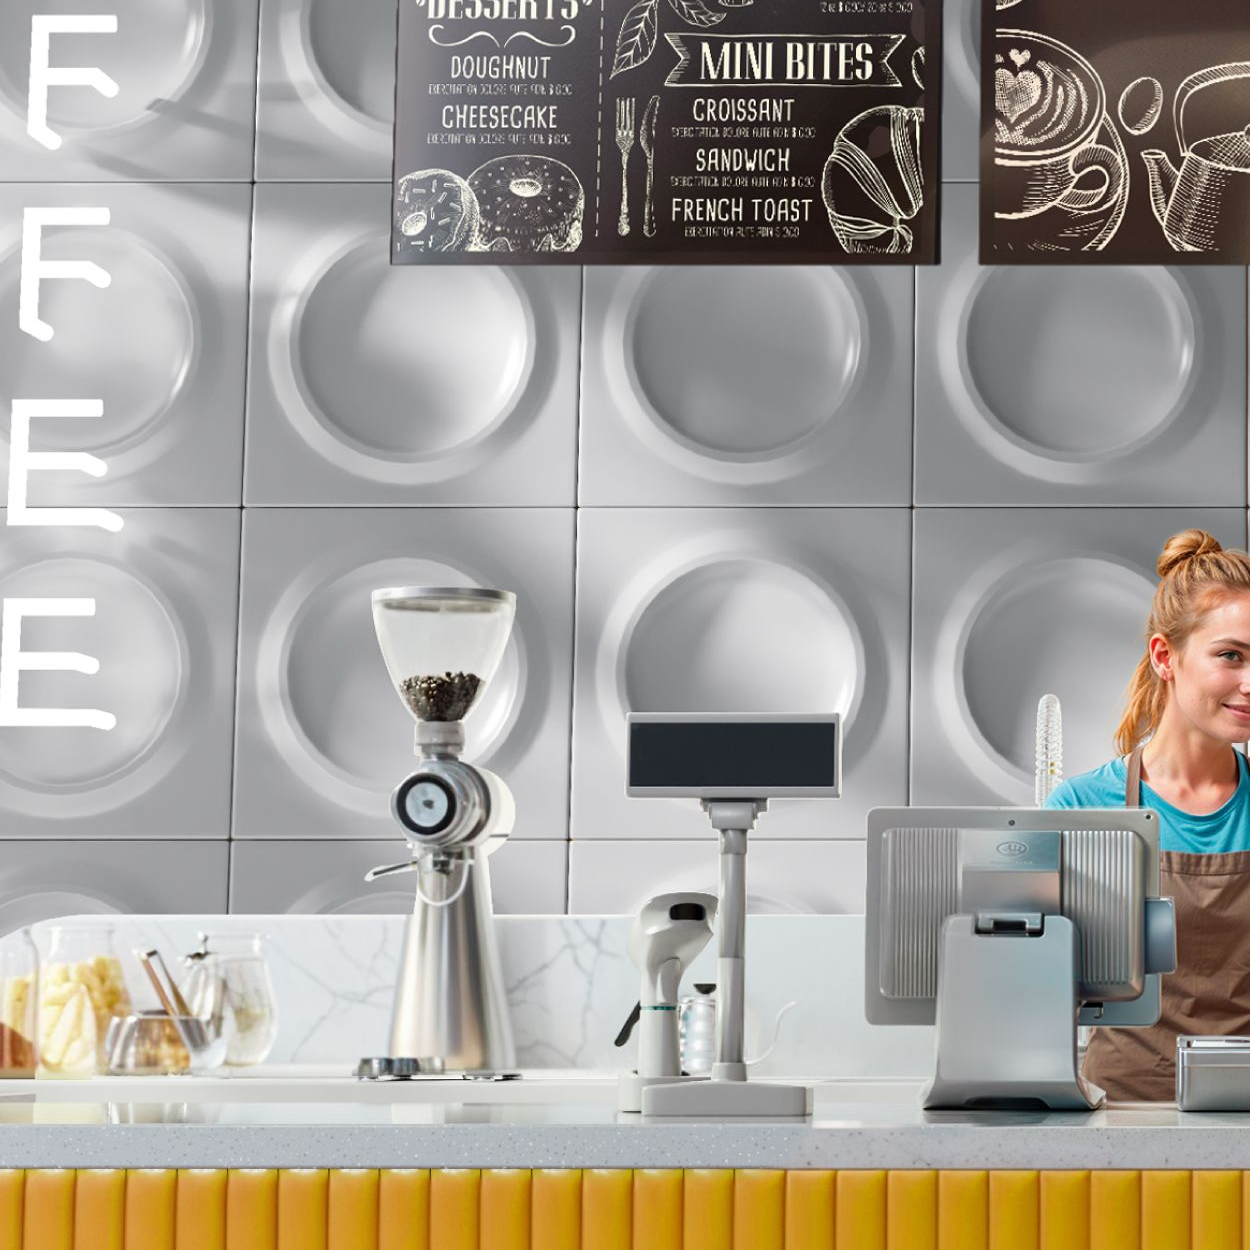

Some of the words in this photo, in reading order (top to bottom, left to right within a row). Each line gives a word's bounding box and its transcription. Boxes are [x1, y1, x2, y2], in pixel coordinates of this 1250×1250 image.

[451, 55, 551, 79] DOUGHNUT
[701, 42, 773, 80] MINI
[786, 42, 873, 80] BITES
[442, 105, 558, 129] CHEESECAKE
[693, 98, 795, 122] CROISSANT
[696, 148, 790, 171] SANDWICH
[672, 198, 743, 222] FRENCH
[752, 199, 813, 222] TOAST
